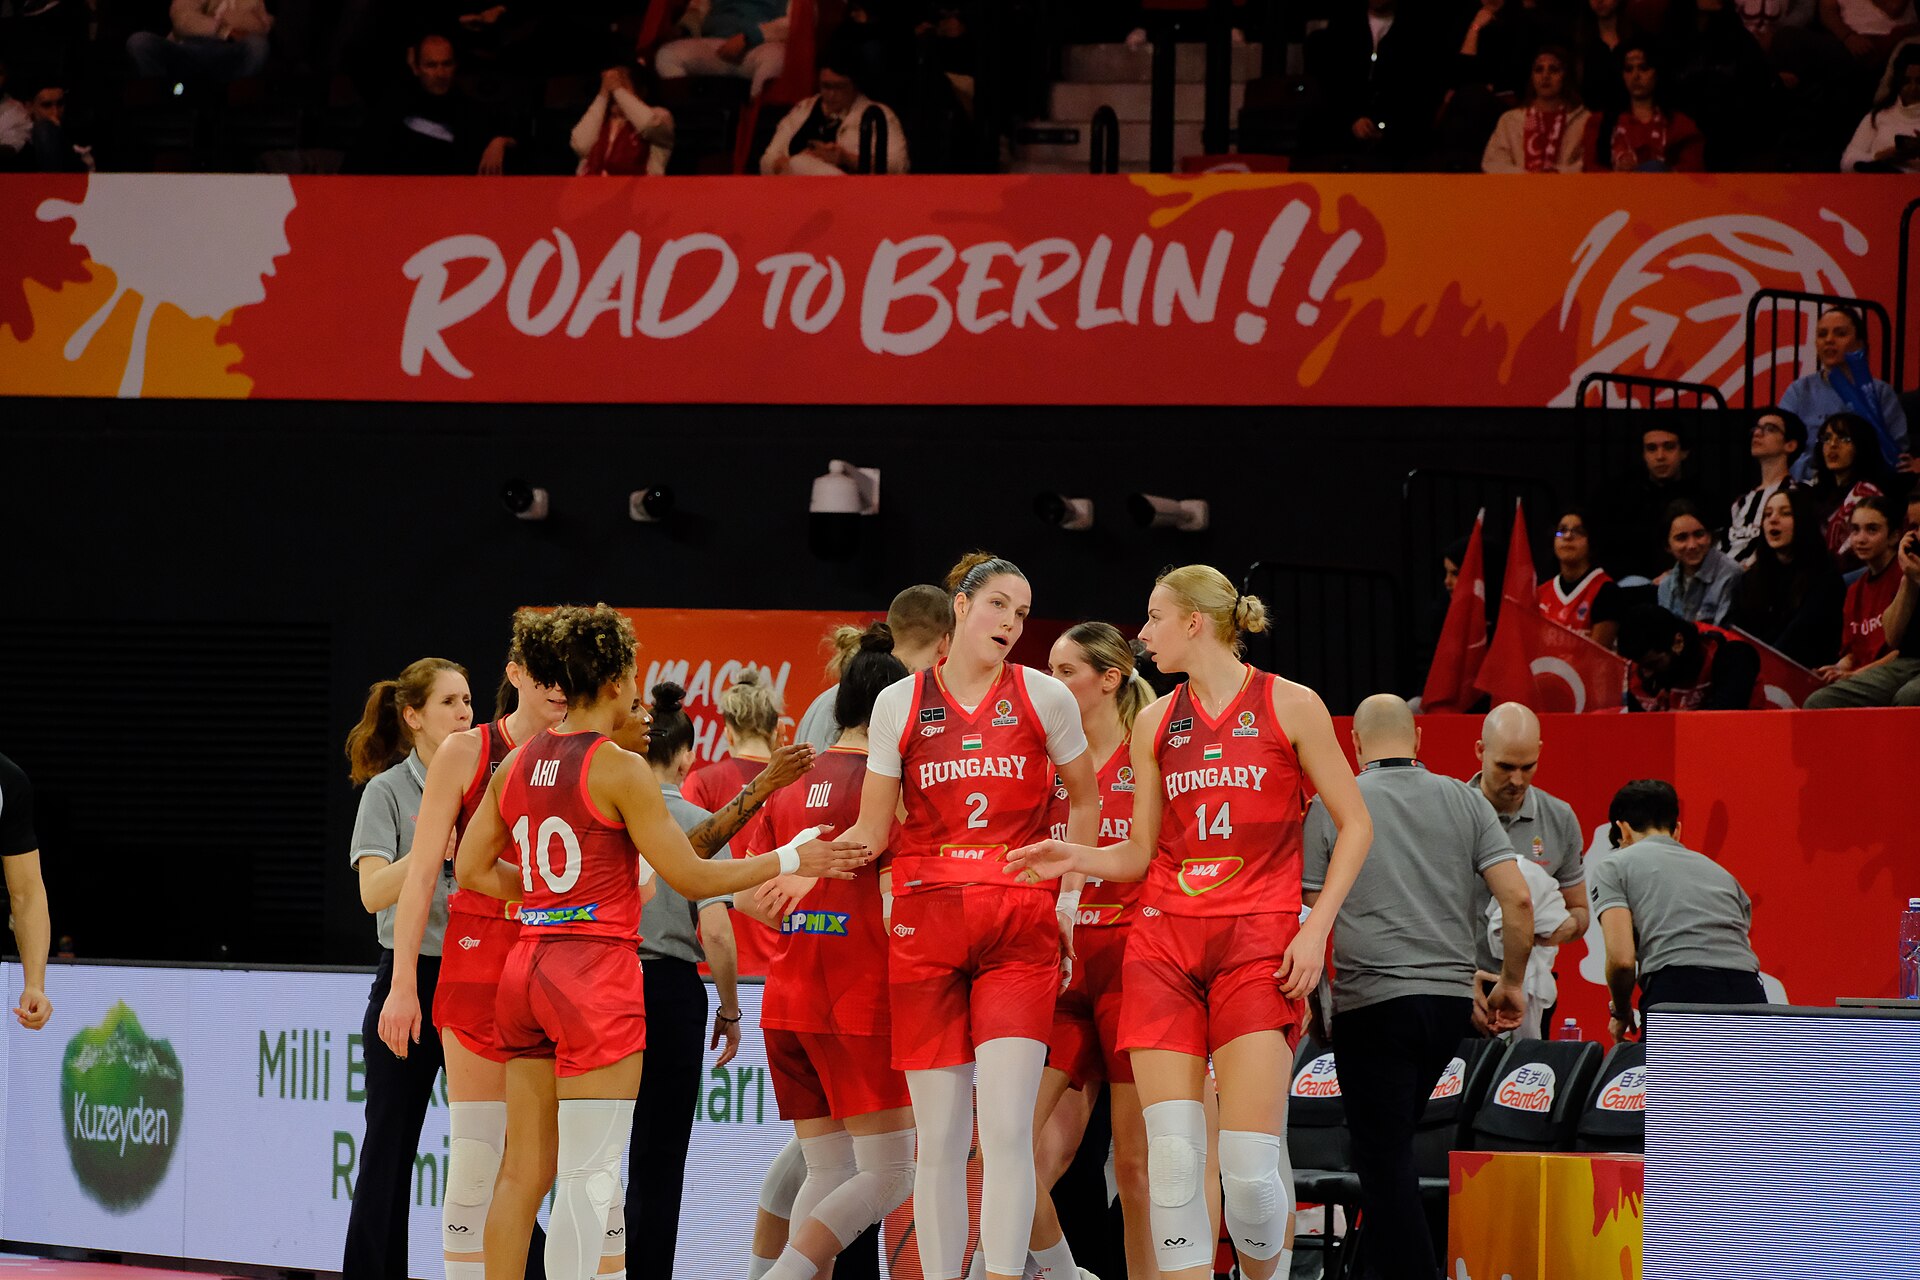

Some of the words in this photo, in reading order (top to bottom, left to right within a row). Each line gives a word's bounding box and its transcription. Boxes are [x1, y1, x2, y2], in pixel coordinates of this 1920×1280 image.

[401, 227, 740, 380] ROAD
[755, 251, 846, 335] TO
[860, 199, 1363, 357] BERLIN!!
[1850, 613, 1883, 636] TÜRK
[529, 759, 561, 787] AHO
[919, 754, 1027, 790] HUNGARY
[1165, 765, 1268, 801] HUNGARY
[805, 780, 832, 808] DÚL
[965, 792, 989, 829] 2
[1195, 801, 1233, 841] 14
[512, 815, 582, 894] 10
[257, 1028, 331, 1102] Milli
[1515, 1067, 1551, 1088] 百岁山
[1620, 1071, 1646, 1088] 百岁
[1296, 1073, 1342, 1097] Gante
[73, 1091, 170, 1158] Kuzeyden
